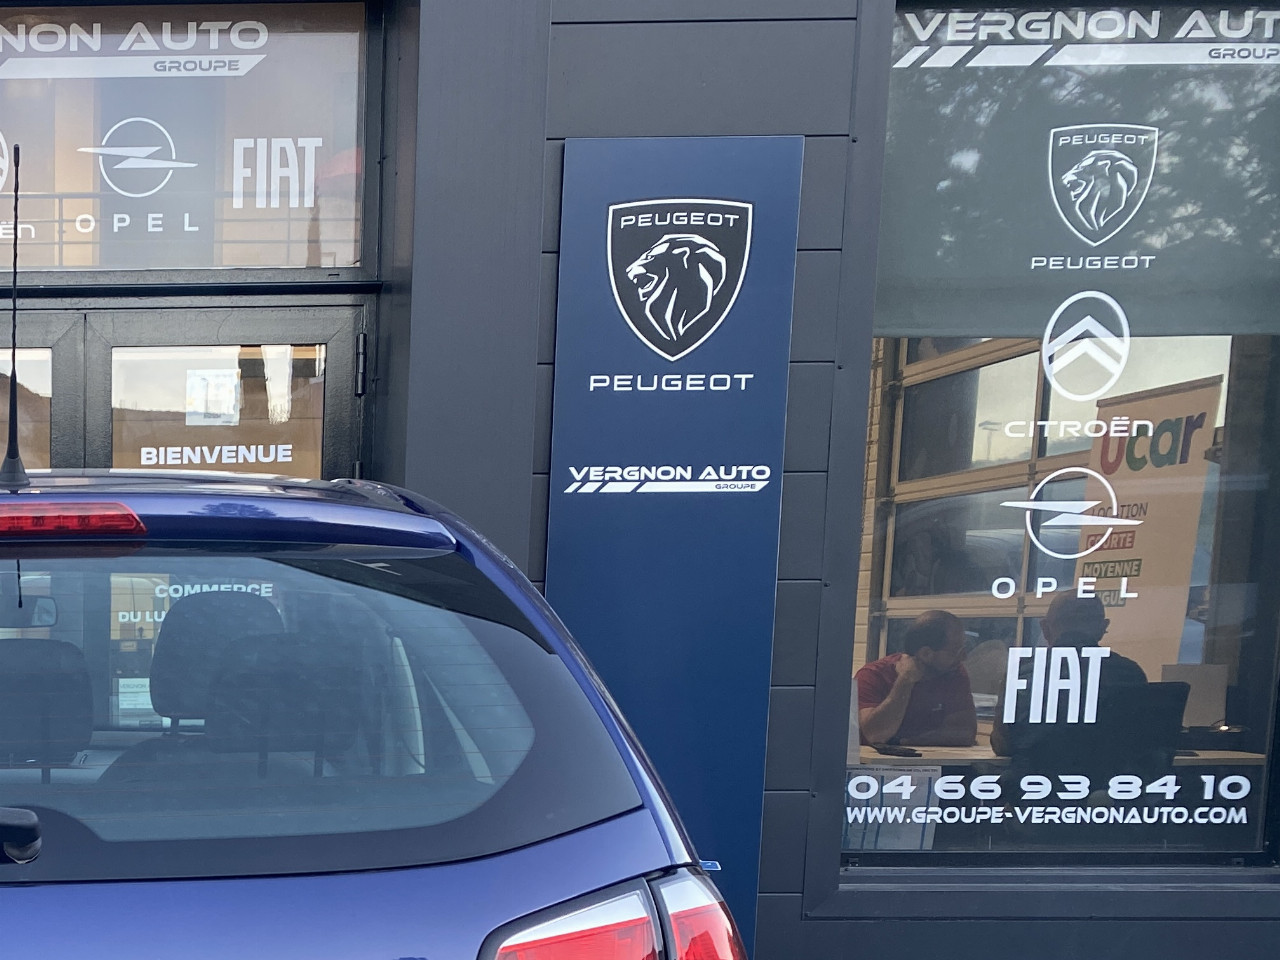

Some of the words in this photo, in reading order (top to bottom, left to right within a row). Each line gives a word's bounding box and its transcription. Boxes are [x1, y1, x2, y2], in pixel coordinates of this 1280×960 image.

[904, 11, 1160, 40] VERGNON
[117, 20, 268, 51] AUTO
[1208, 48, 1280, 59] GROUP
[153, 60, 240, 72] GROUPE
[1058, 133, 1148, 146] PEUGEOT
[233, 138, 322, 208] FIAT
[75, 214, 200, 234] OPEL
[620, 212, 740, 229] PEUGEOT
[1030, 256, 1156, 270] PEUGEOT
[589, 373, 754, 391] PEUGEOT
[1004, 416, 1154, 438] CITROËN
[140, 444, 293, 465] BIENVENUE
[569, 466, 692, 480] VERGNON
[698, 465, 770, 480] AUTO
[714, 482, 757, 490] GROUPE
[1092, 502, 1148, 520] OCTION
[1083, 561, 1140, 577] MOYENNE
[991, 577, 1139, 599] OPEL
[118, 610, 142, 622] DU
[1002, 646, 1111, 723] FIAT
[847, 775, 917, 800] 04
[934, 775, 1002, 800] 66
[1020, 775, 1091, 800] 93
[1108, 775, 1181, 800] 84
[1200, 775, 1251, 800] 10
[846, 806, 1248, 824] WWW.GROUPE-VERGNONAUTO.COM
